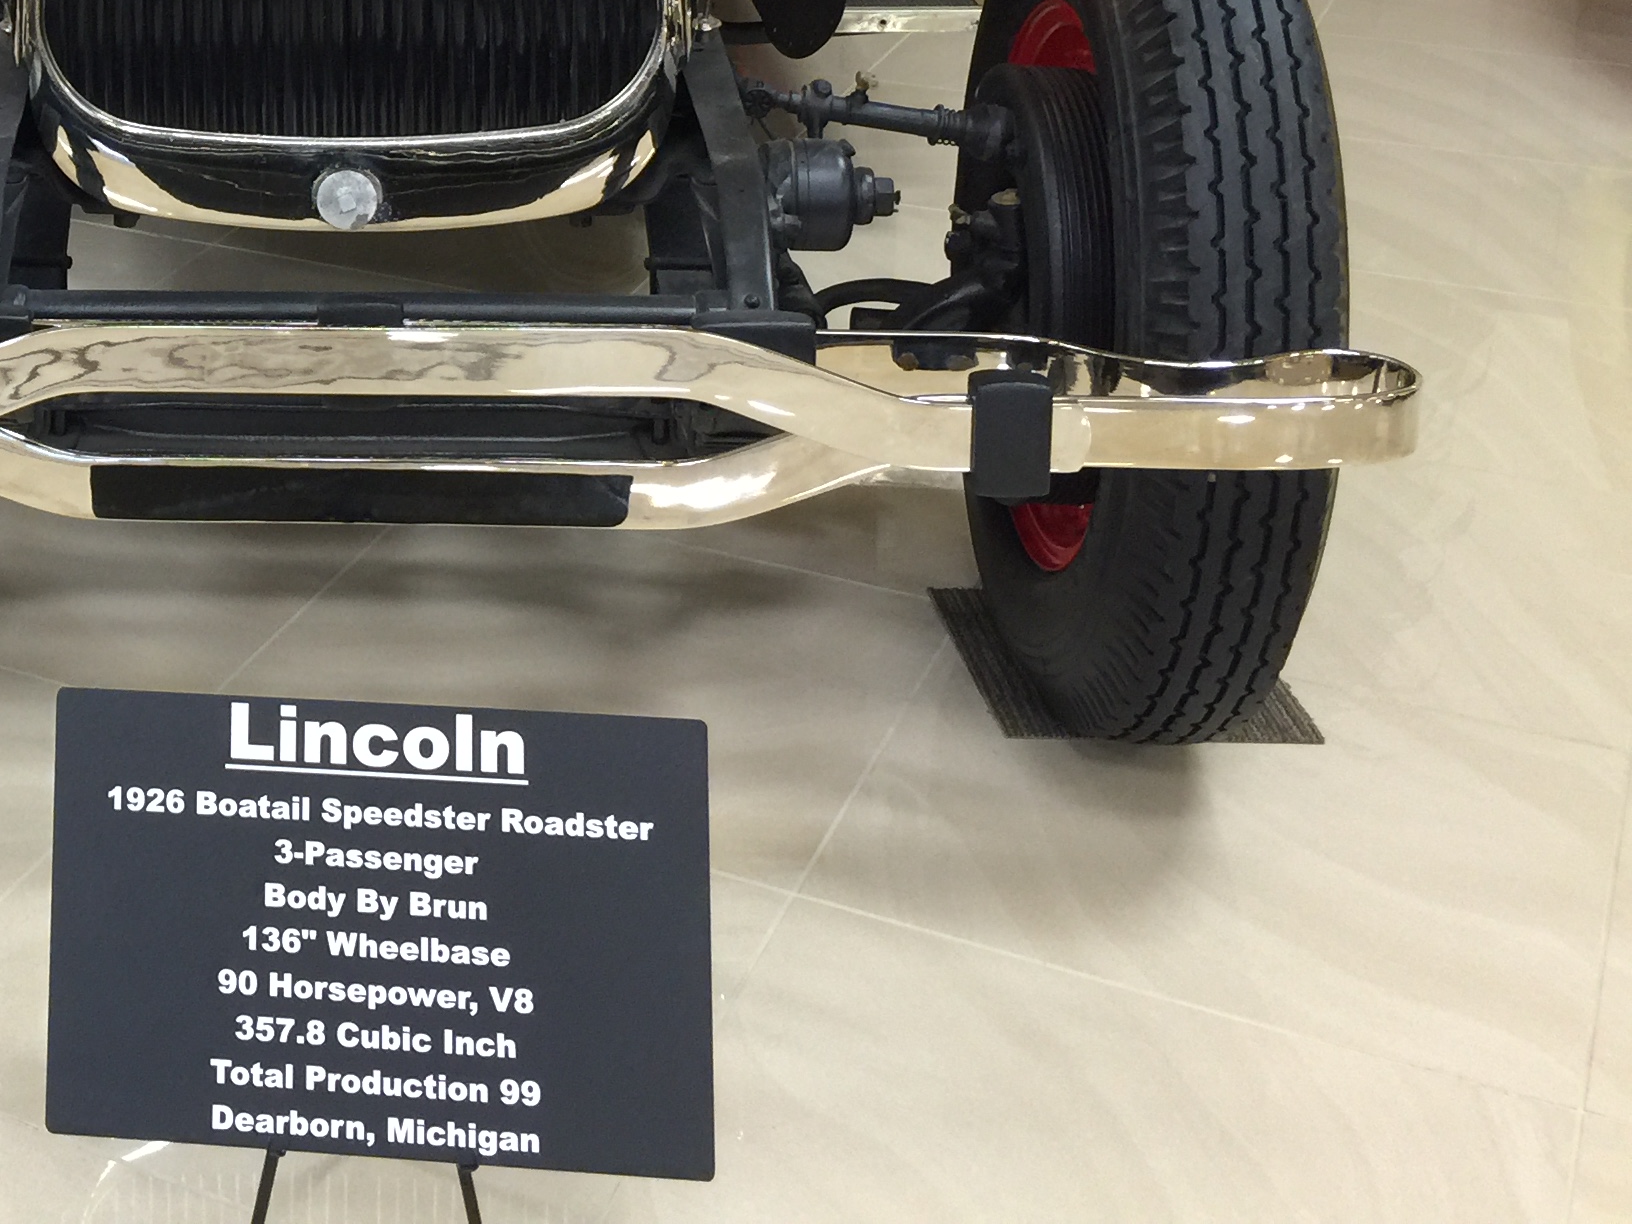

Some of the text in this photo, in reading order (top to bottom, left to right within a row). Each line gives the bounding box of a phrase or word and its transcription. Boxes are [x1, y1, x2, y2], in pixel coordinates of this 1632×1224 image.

[229, 702, 526, 775] Lincoln
[108, 786, 654, 840] 1926 Boatail Speedster Roadster
[275, 839, 478, 879] 3-Passenger
[265, 883, 487, 920] Body By Brun
[243, 926, 510, 966] 136" Wheelbase
[218, 969, 533, 1016] 90 Horsepower, V8
[235, 1015, 516, 1058] 357.8 Cubic Inch
[210, 1059, 540, 1106] Total Production 99
[212, 1105, 539, 1156] Dearborn, Michigan
